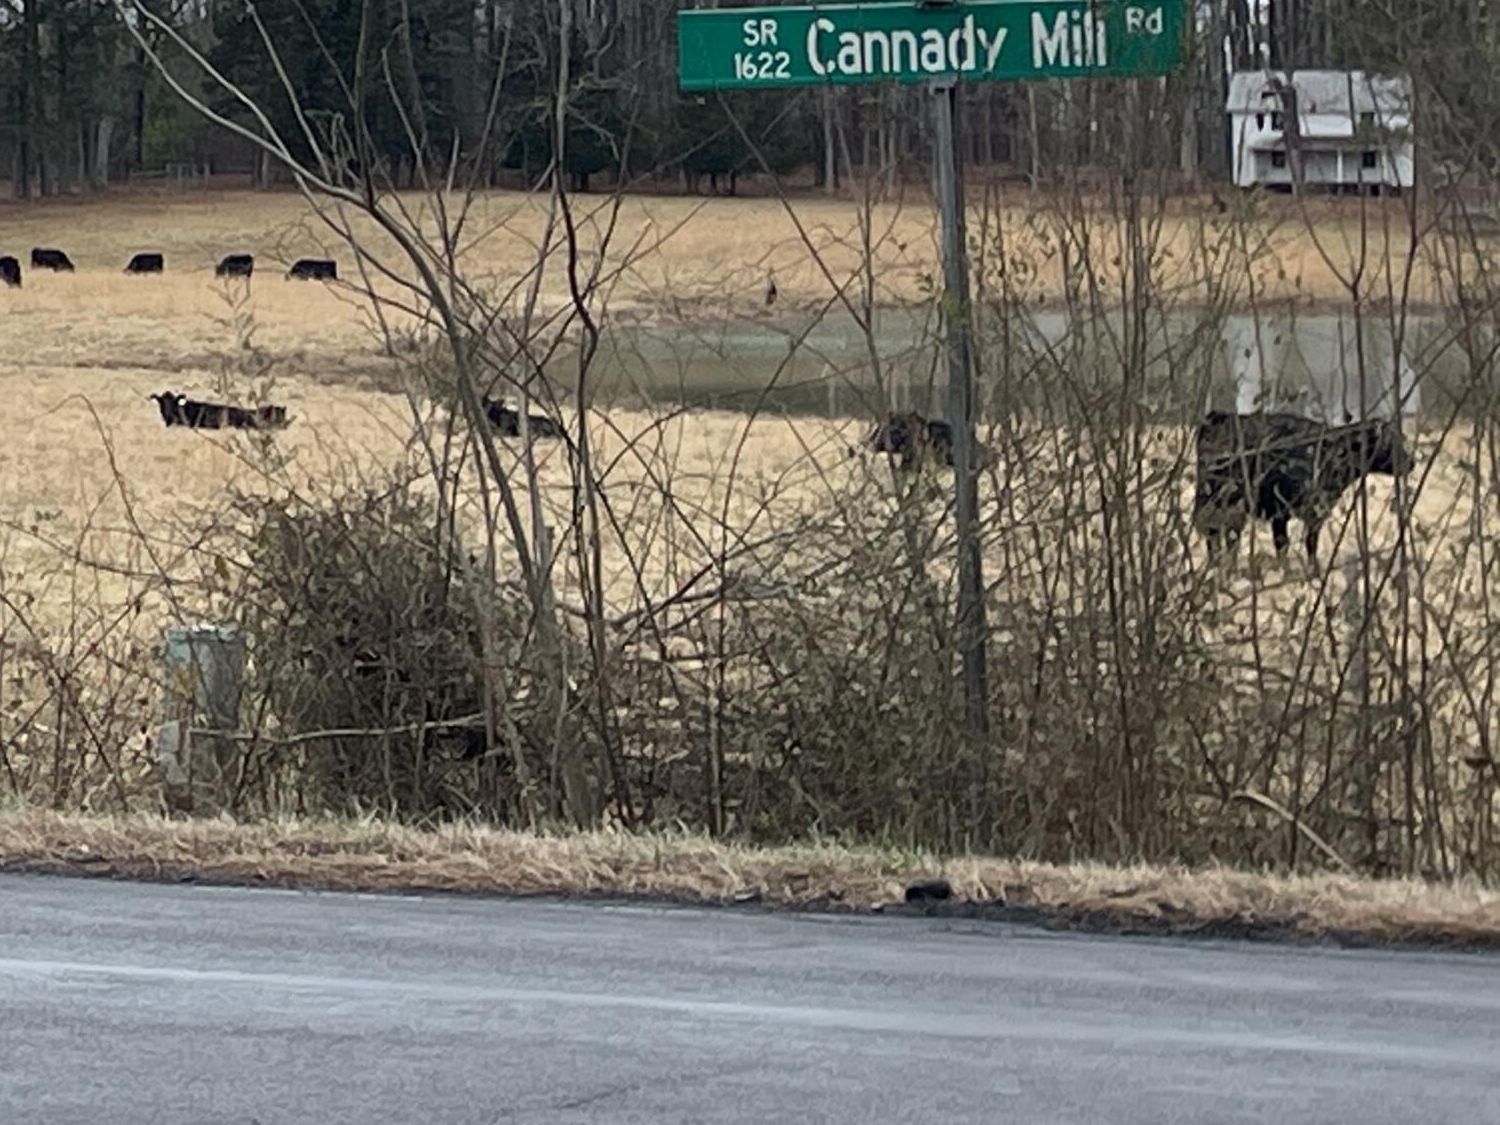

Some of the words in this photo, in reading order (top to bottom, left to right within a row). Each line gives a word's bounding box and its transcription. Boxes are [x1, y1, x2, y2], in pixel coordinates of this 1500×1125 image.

[743, 19, 778, 46] SR
[807, 17, 1008, 76] Cannady
[1032, 10, 1107, 70] Mill
[1126, 6, 1164, 35] Rd
[734, 52, 791, 80] 1622
